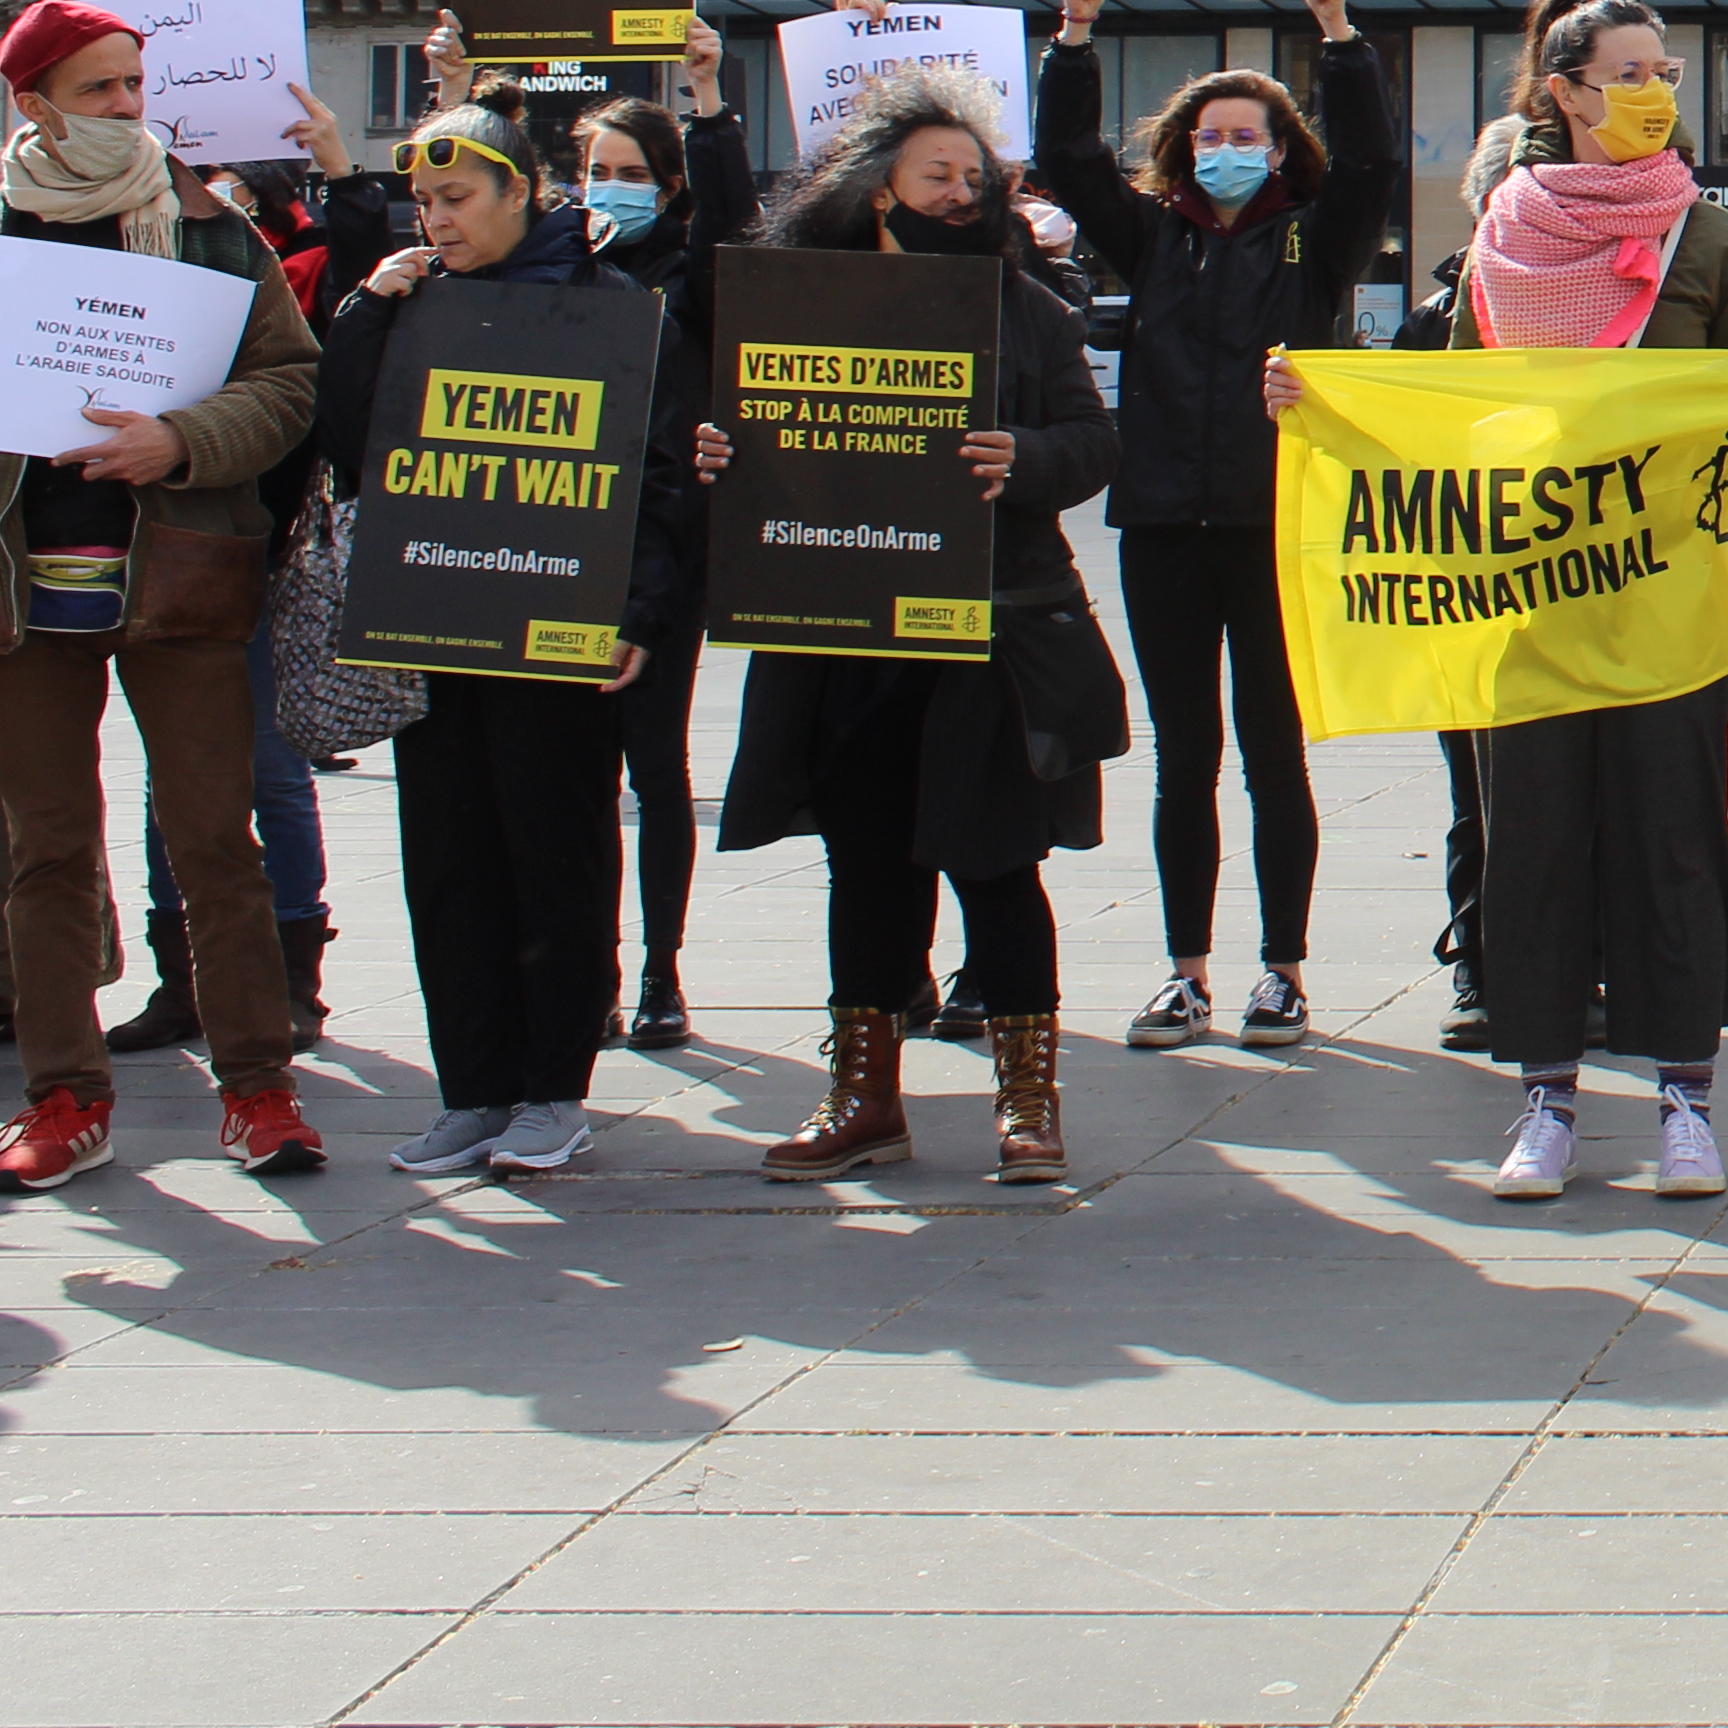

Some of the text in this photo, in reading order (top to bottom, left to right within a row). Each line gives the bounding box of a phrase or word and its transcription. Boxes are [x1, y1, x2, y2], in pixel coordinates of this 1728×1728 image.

[138, 1, 201, 38] اليمن
[621, 17, 663, 29] AMNESTY
[151, 53, 275, 95] لا للحصار
[75, 297, 145, 319] YÉMEN
[35, 320, 175, 353] NON AUX VENTES
[55, 340, 144, 365] D'ARMES À
[15, 353, 175, 389] L'ARABIE SAOUDITE
[746, 352, 964, 390] VENTES D'ARMES
[442, 382, 580, 436] YEMEN
[739, 397, 968, 428] STOP À LA COMPLICITÉ
[779, 428, 927, 454] DE LA FRANCE
[384, 447, 619, 509] CAN'T WAIT
[1341, 444, 1662, 555] AMNESTY
[761, 519, 941, 551] #SilenceOnArme
[403, 540, 579, 576] #SilenceOnArme
[1341, 528, 1669, 626] INTERNATIONAL
[904, 606, 955, 620] AMNESTY
[536, 629, 587, 645] AMNESTY
